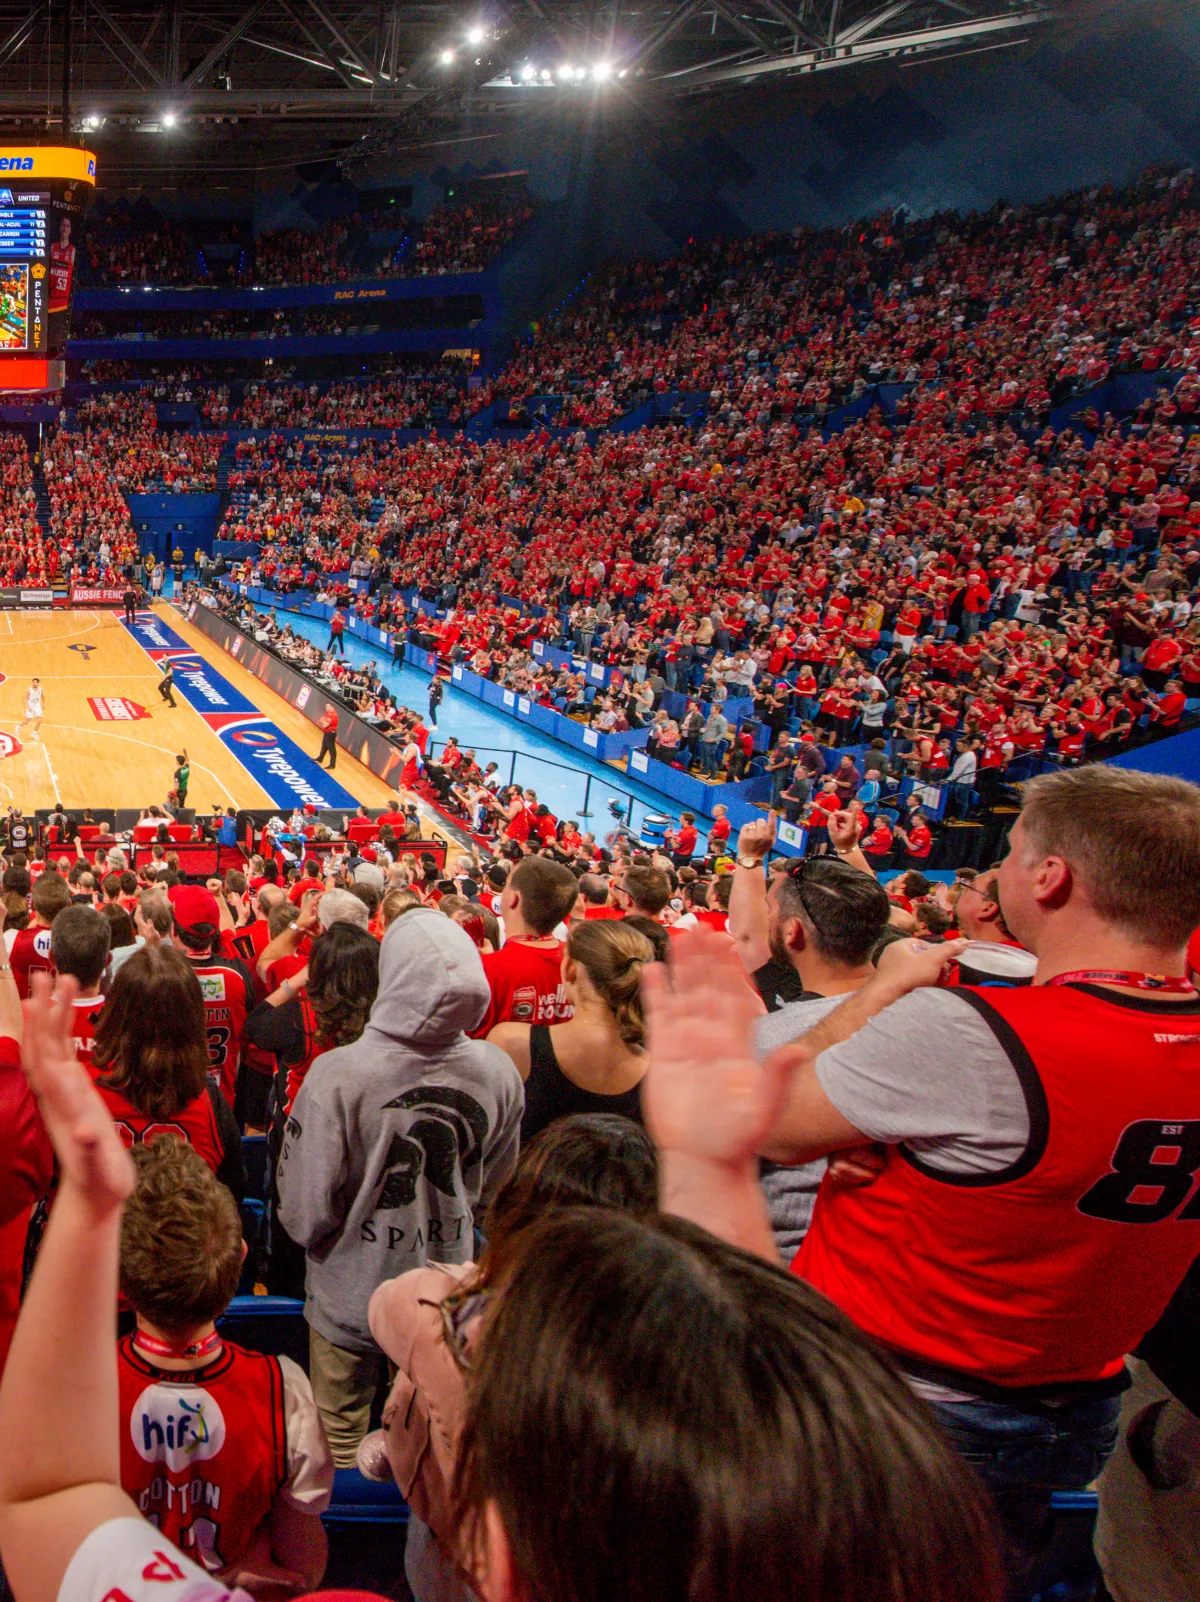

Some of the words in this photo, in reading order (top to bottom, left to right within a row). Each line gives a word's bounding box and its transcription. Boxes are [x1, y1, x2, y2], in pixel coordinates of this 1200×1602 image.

[334, 291, 355, 299] RAC
[358, 289, 386, 298] Arena
[73, 590, 101, 601] AUSSIE
[104, 590, 131, 600] FENC
[180, 671, 229, 705] Tyrepower
[252, 747, 332, 808] Tyrepower
[1162, 1124, 1185, 1135] EST
[361, 1214, 465, 1253] SPART
[142, 1413, 191, 1451] hif
[139, 1475, 221, 1516] COTTON
